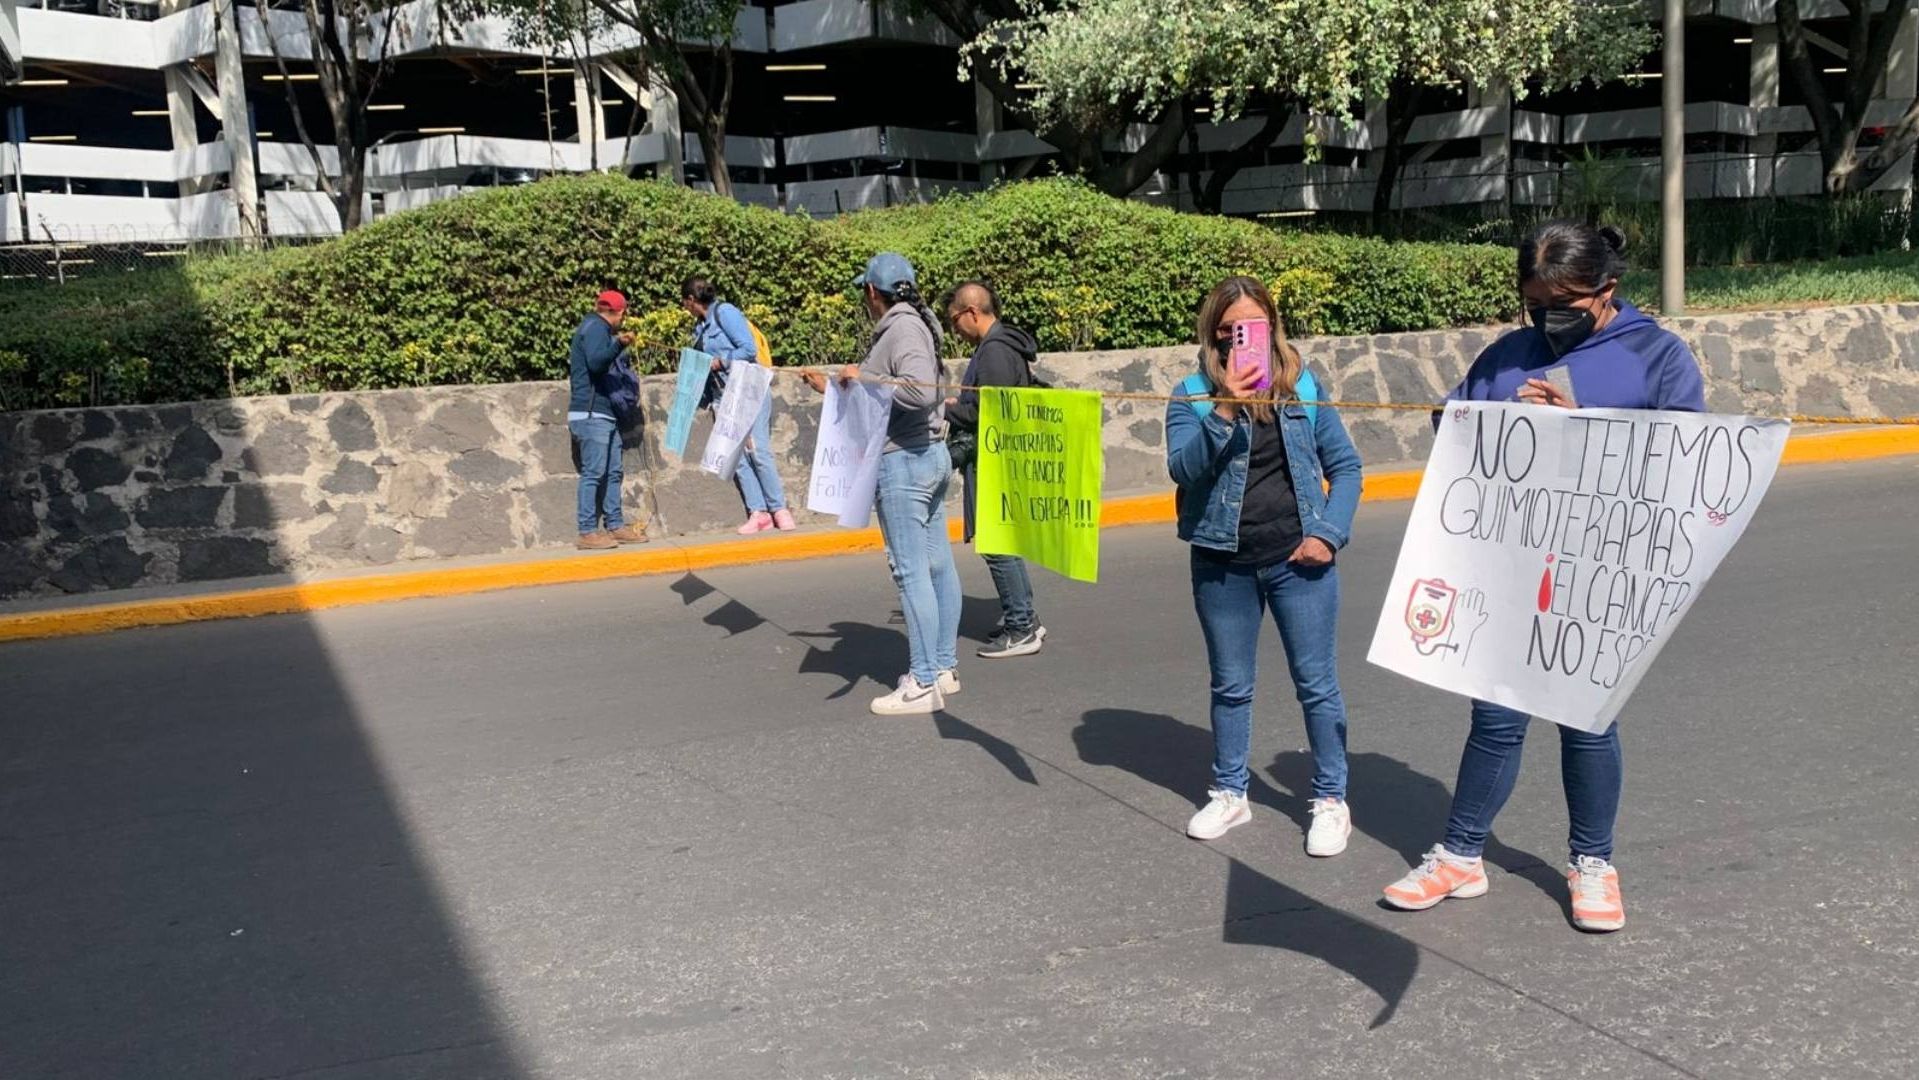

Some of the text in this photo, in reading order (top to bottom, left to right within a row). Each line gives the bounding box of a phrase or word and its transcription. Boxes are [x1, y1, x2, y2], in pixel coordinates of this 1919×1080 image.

[1000, 390, 1064, 424] NO TENEMOS
[1467, 409, 1760, 517] NO TENEMOS
[1439, 476, 1696, 578] QUIMIOTERAPIAS
[1526, 614, 1653, 690] NO ESP
